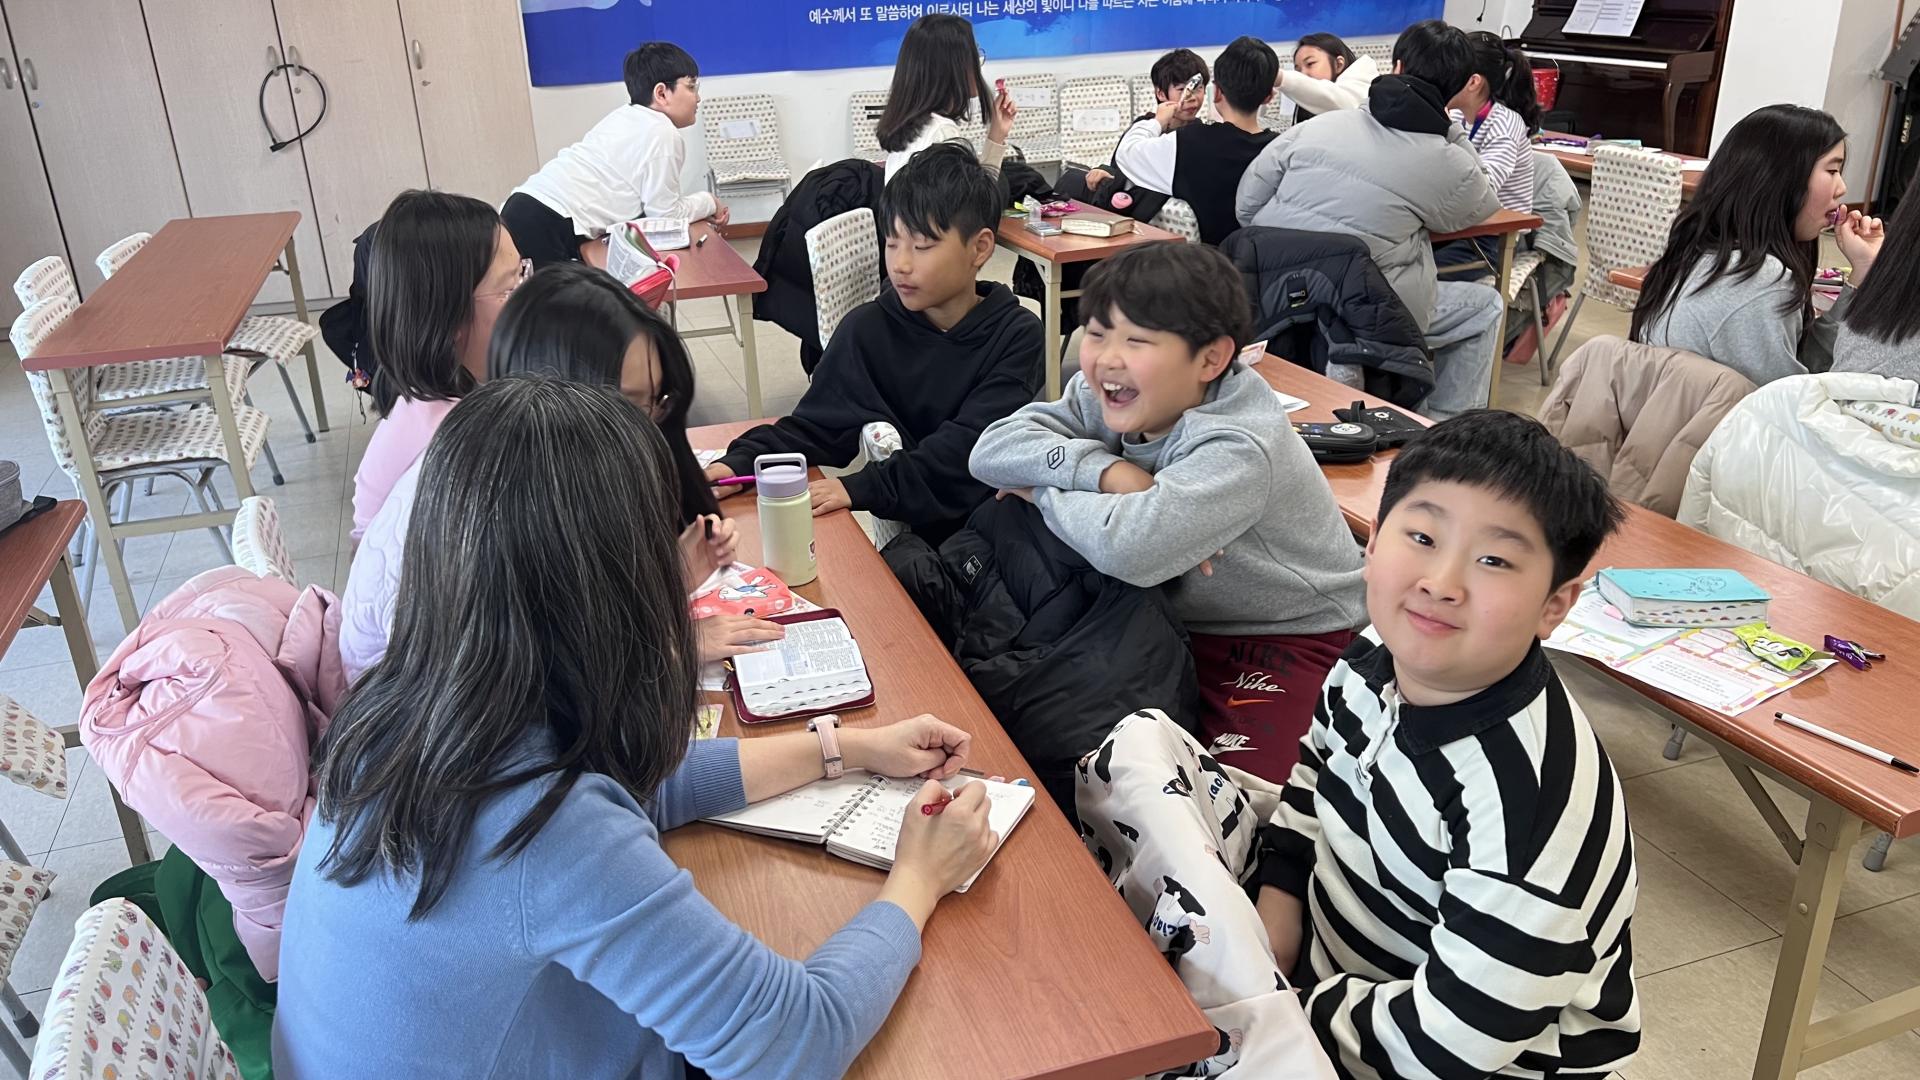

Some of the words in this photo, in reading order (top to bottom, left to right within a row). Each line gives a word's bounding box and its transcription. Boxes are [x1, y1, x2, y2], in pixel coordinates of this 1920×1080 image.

[808, 7, 857, 25] 예수께서
[860, 7, 874, 21] 또
[875, 3, 924, 22] 말씀하여
[976, 0, 1000, 17] 나는
[1002, 0, 1038, 16] 세상의
[1041, 0, 1075, 14] 빛이니
[1219, 672, 1287, 693] Nike
[1214, 732, 1251, 748] NIKE
